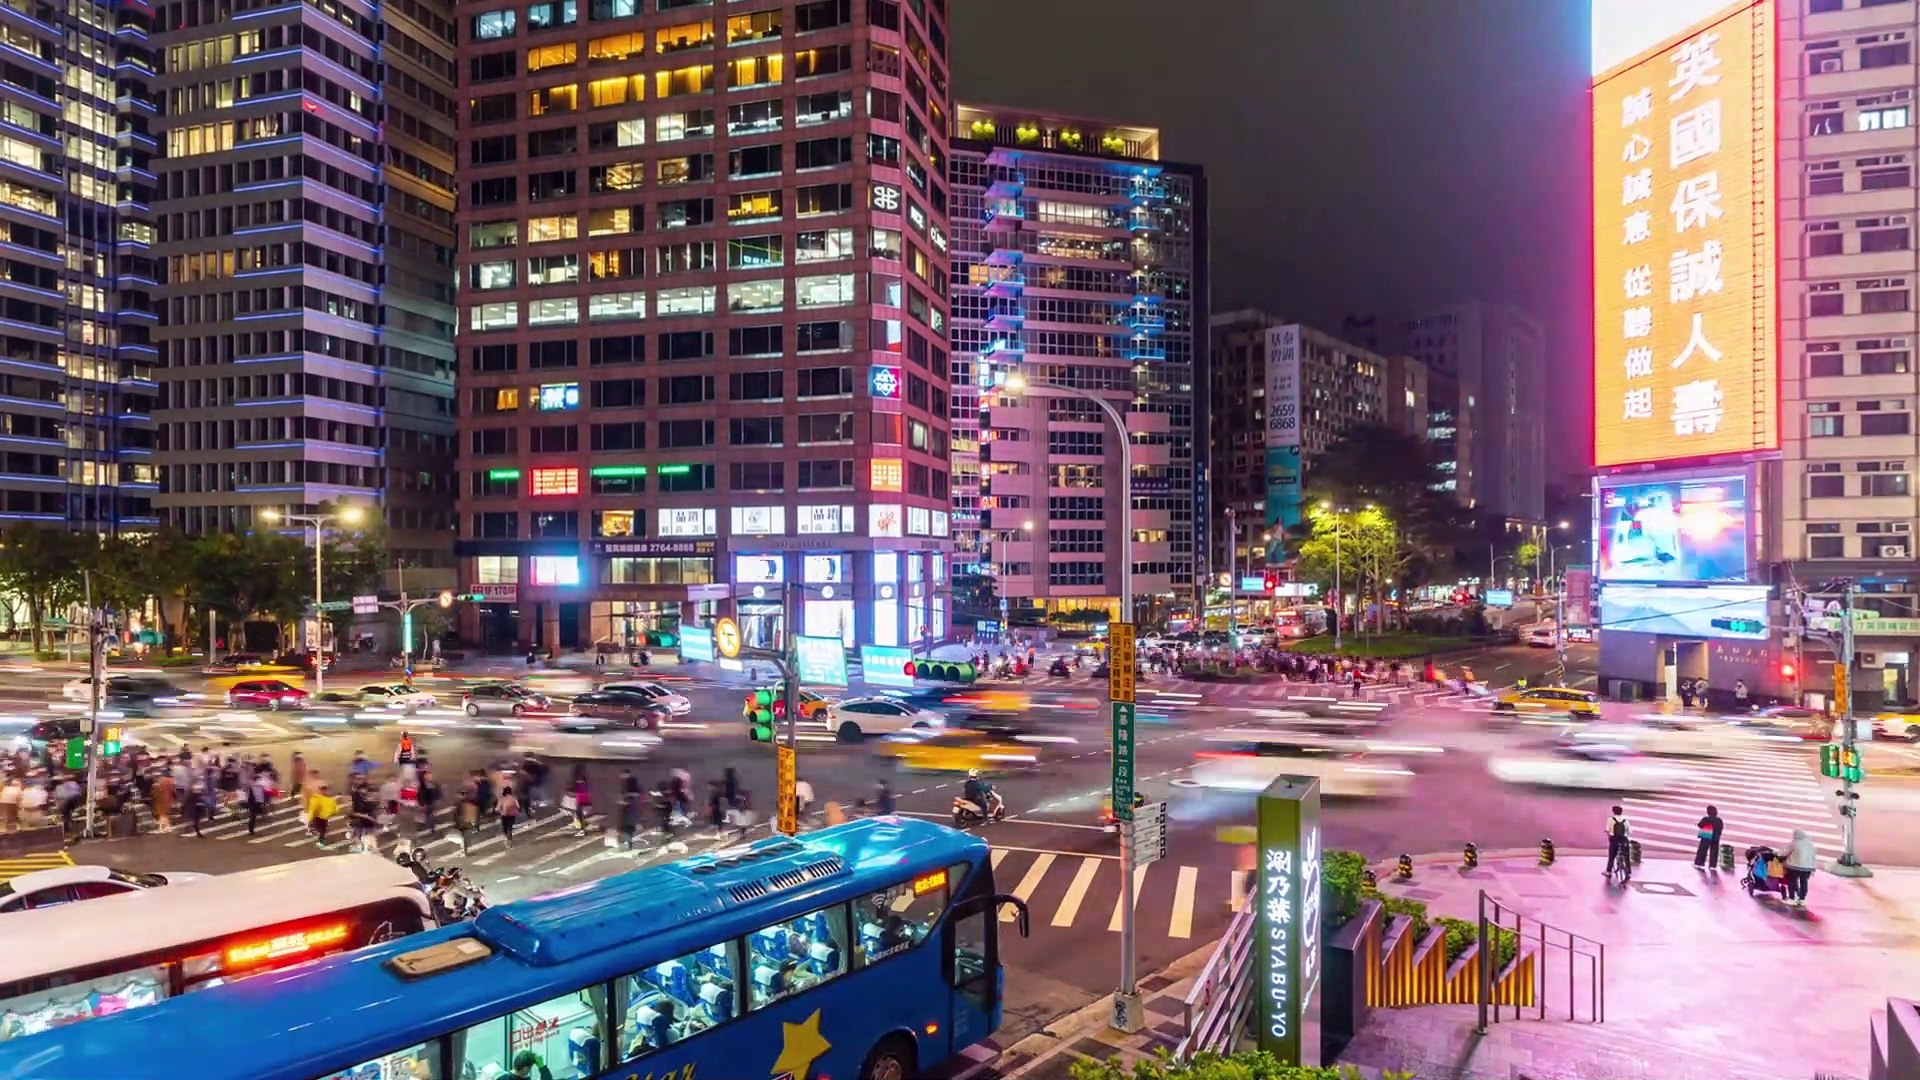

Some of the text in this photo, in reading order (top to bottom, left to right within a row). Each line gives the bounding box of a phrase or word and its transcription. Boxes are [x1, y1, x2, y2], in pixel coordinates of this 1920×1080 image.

[1668, 32, 1724, 436] 英國保誠人壽
[1270, 403, 1295, 418] 2659
[1270, 417, 1295, 430] 6868
[1118, 714, 1129, 778] 基隆路一段
[1266, 849, 1291, 923] 涮乃葉
[1271, 927, 1288, 1038] SYABU-YO
